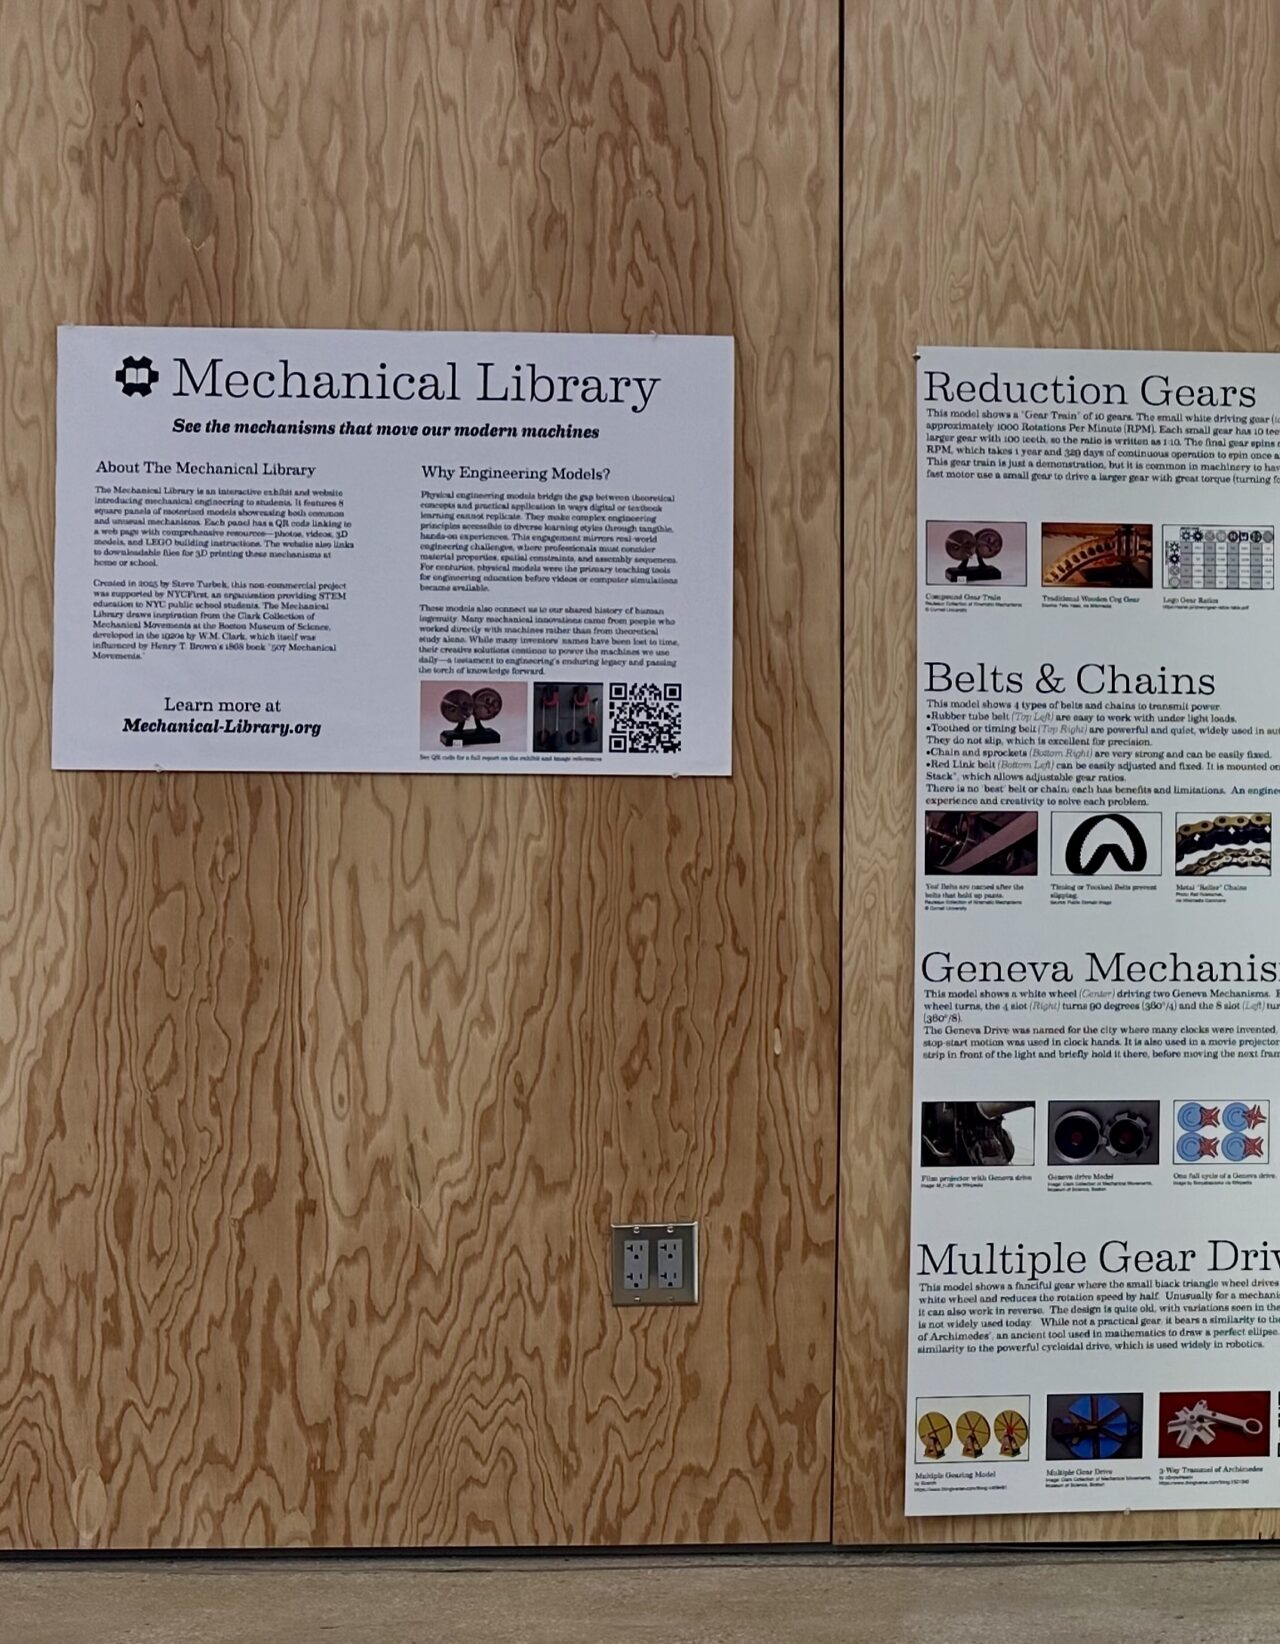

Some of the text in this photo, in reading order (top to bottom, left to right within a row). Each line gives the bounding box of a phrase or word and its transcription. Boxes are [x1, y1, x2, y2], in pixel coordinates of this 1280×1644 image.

[172, 358, 661, 414] Mechanical Library
[924, 371, 1255, 408] Reduction Gears
[172, 418, 599, 439] See the mechanisms that move our modern machines
[96, 460, 316, 478] About The Mechanical Library
[421, 465, 610, 482] Why Engineering Models?
[1128, 474, 1149, 484] gear
[1151, 473, 1172, 482] with
[1175, 475, 1198, 484] great
[1201, 475, 1230, 485] torque
[1233, 474, 1270, 485] (turning
[93, 610, 315, 623] Library draws inspiration from the Clark Collection of
[418, 665, 431, 674] the
[433, 666, 454, 674] torch
[466, 666, 509, 676] knowledge
[924, 662, 1214, 695] Belts & Chains
[164, 697, 281, 713] Learn more at
[122, 718, 321, 738] Mechanical-Library.org
[925, 796, 977, 806] experience
[980, 796, 998, 805] and
[1000, 797, 1044, 807] creativity
[1047, 798, 1056, 806] to
[1058, 797, 1081, 806] solve
[1083, 797, 1105, 806] each
[922, 951, 1073, 983] Geneva
[923, 1026, 942, 1035] The
[945, 1025, 981, 1035] Geneva
[983, 1025, 1009, 1035] Drive
[1032, 1025, 1065, 1035] named
[917, 1241, 1088, 1281] Multiple
[1099, 1240, 1195, 1274] Gear
[978, 1344, 994, 1353] the
[996, 1342, 1039, 1354] powerful
[1041, 1342, 1083, 1353] cycloidal
